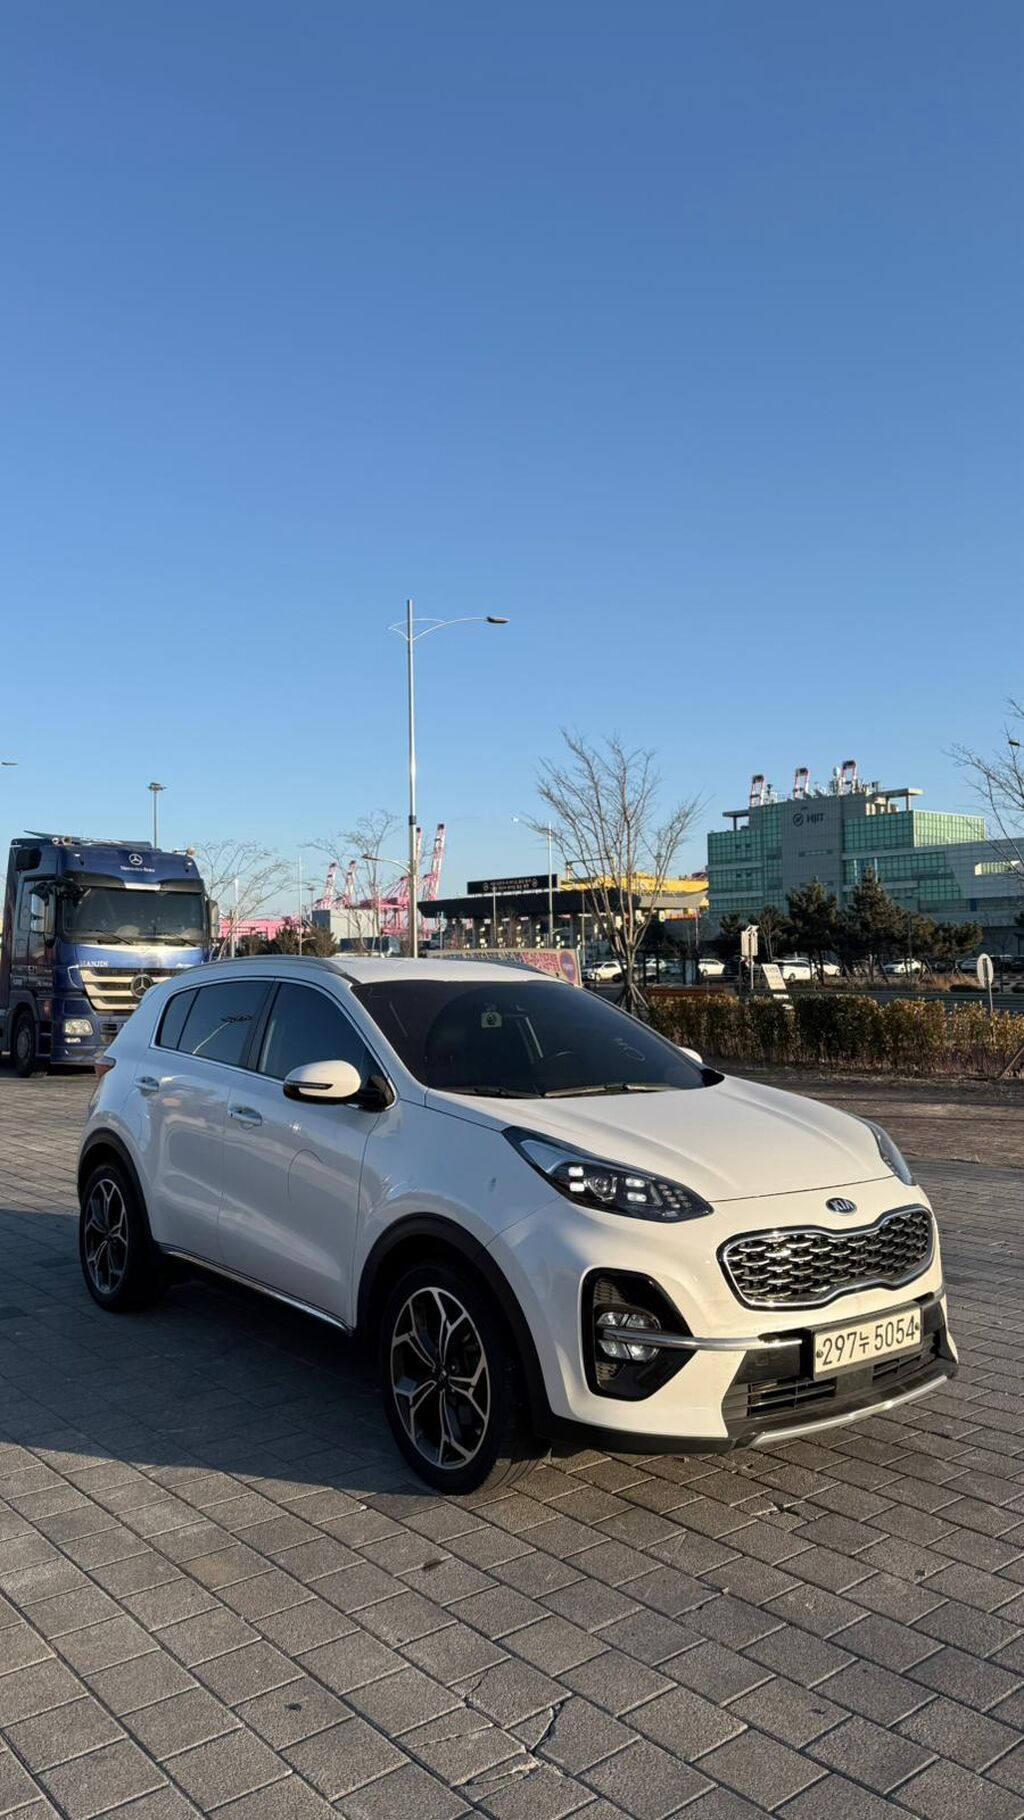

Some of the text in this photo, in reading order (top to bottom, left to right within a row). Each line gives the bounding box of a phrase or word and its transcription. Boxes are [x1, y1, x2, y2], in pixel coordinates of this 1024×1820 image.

[829, 1199, 855, 1211] KIA
[822, 1315, 916, 1366] 297누 5054
